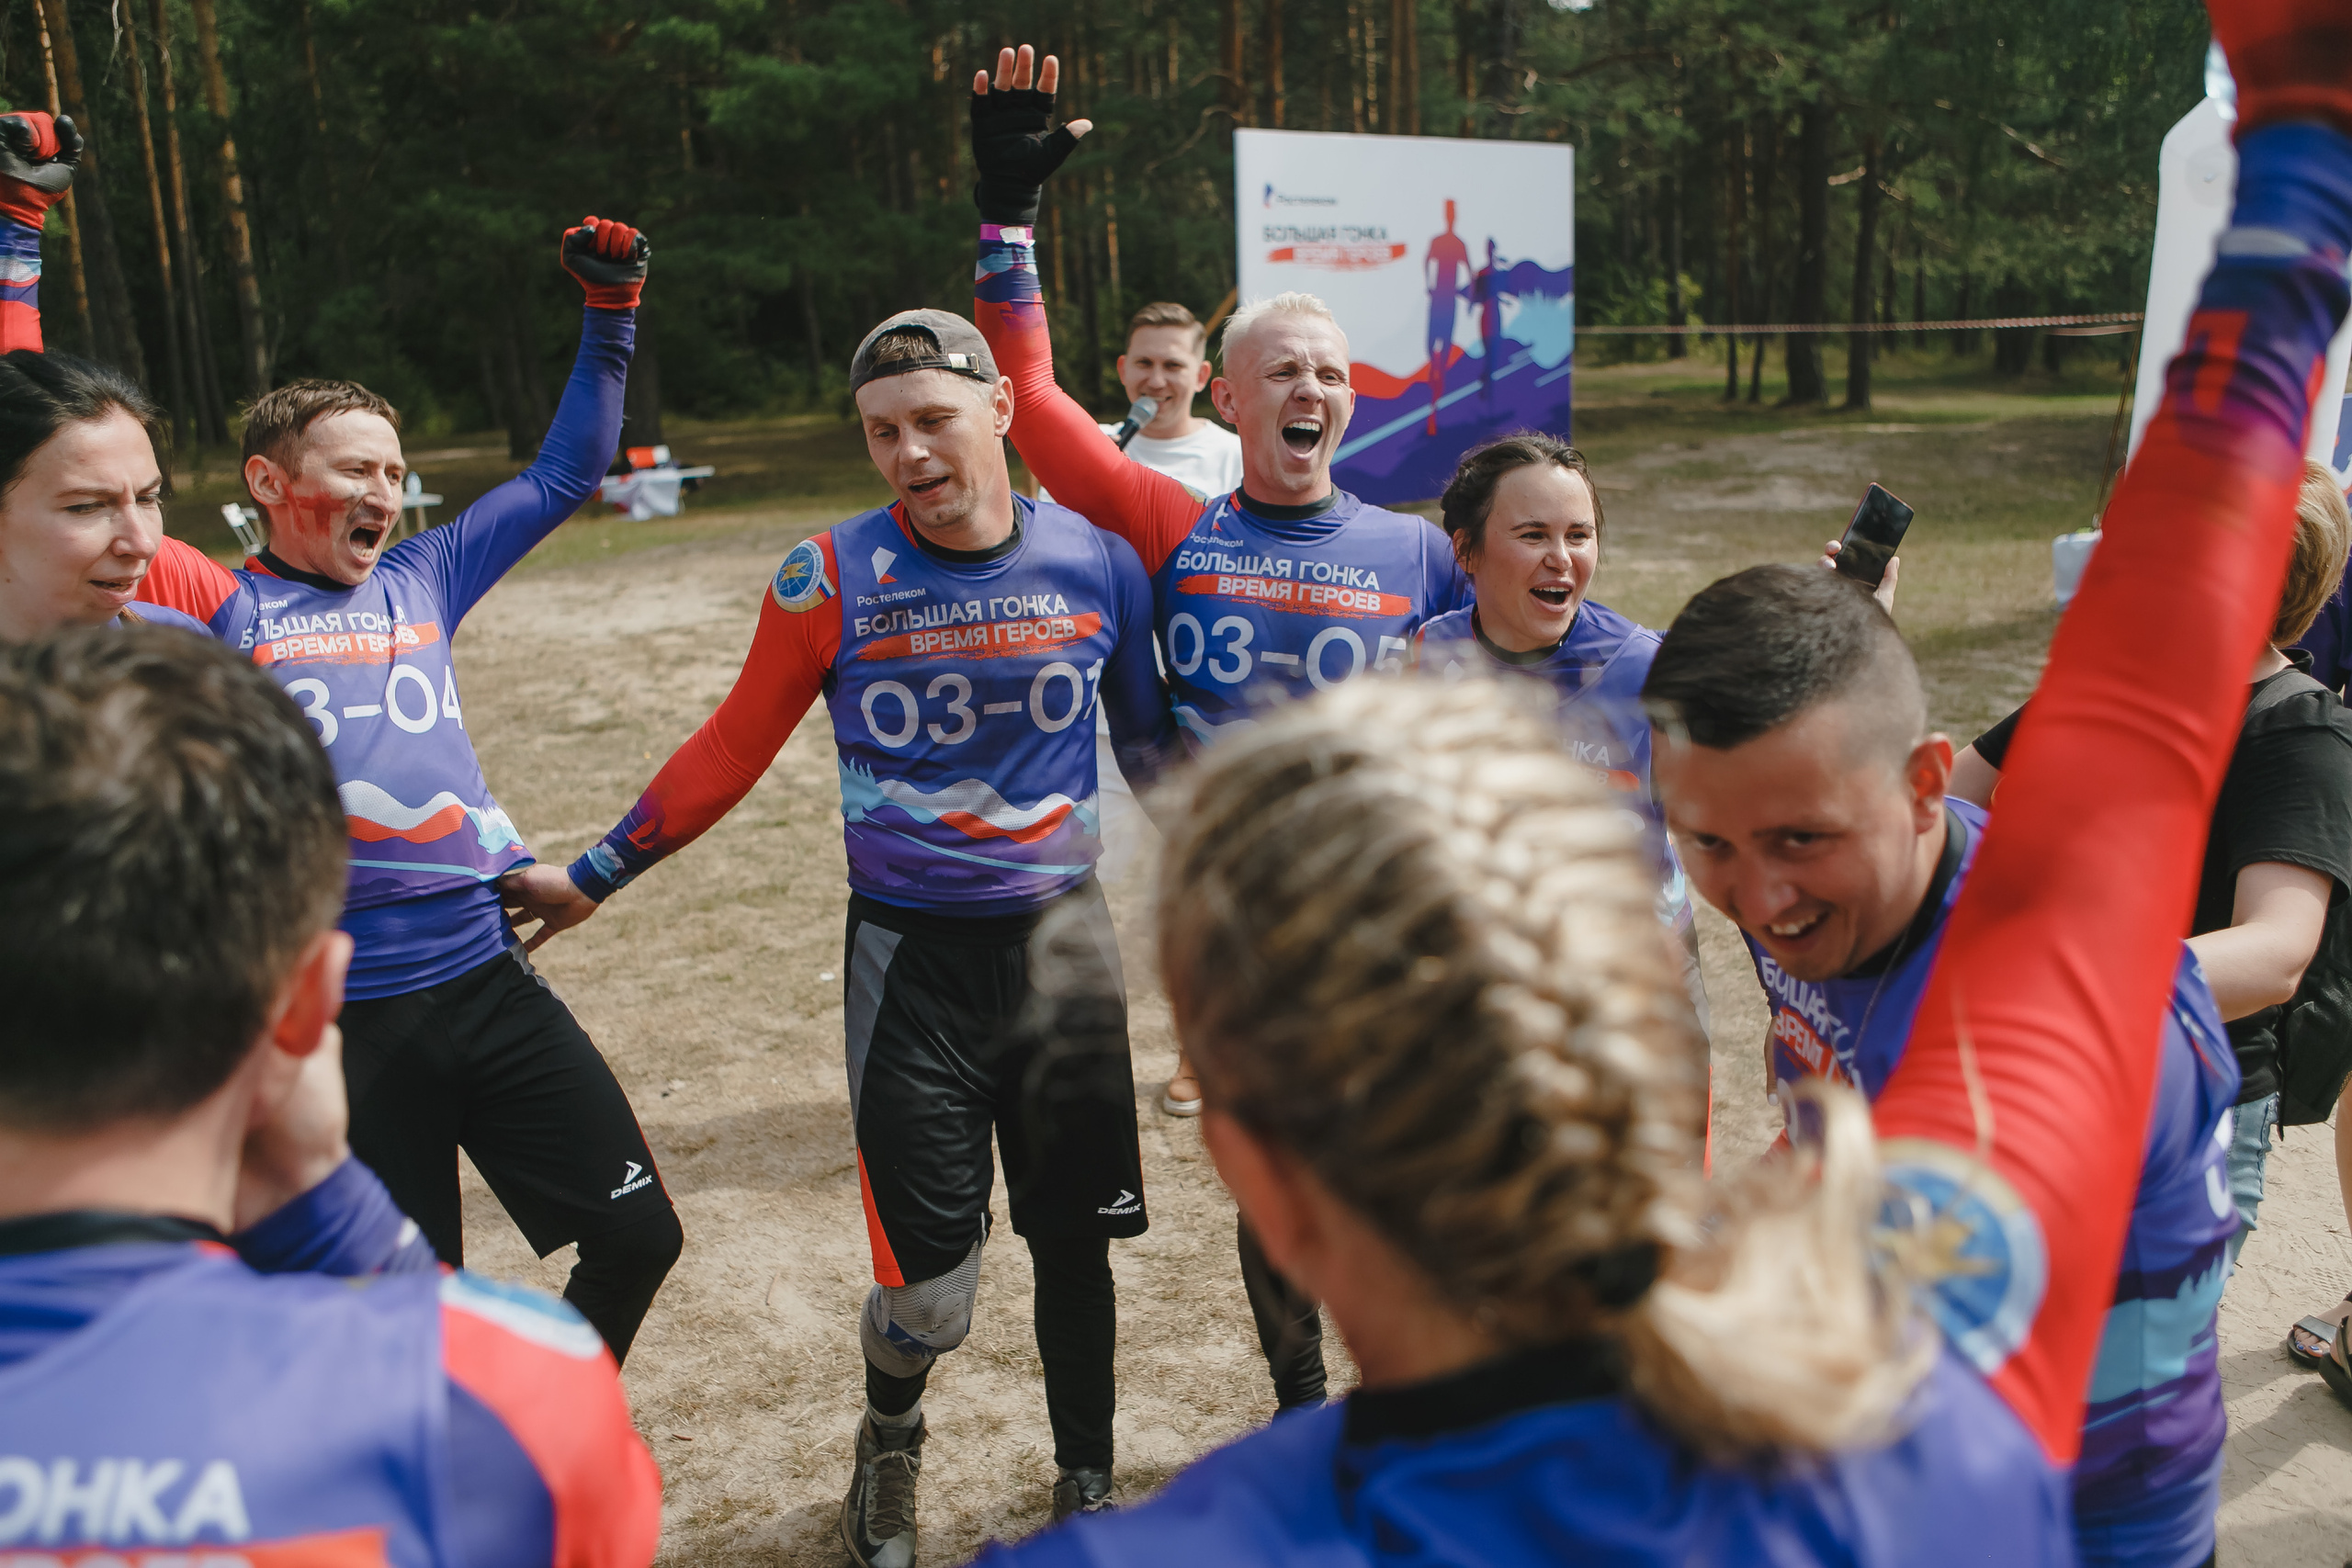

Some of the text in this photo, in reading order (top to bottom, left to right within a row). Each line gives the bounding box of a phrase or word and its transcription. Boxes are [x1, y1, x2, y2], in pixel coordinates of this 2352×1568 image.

[1176, 549, 1381, 591] БОЛЬШАЯ ГОНКА
[856, 587, 926, 607] Ростелеком
[1216, 576, 1382, 612] ВРЕМЯ ГЕРОЕВ
[238, 604, 409, 649] БЛЬШАЯ ГОНА
[854, 593, 1069, 637] БОЛЬШАЯ ГОНКА
[271, 634, 353, 660] ВРЕМЯ
[910, 619, 1077, 654] ВРЕМЯ ГЕРОЕВ
[283, 663, 463, 749] 3-04
[860, 657, 1104, 749] 03-01
[1563, 738, 1611, 767] НКА
[610, 1174, 652, 1200] DEMIX
[1097, 1202, 1141, 1214] DEMIX
